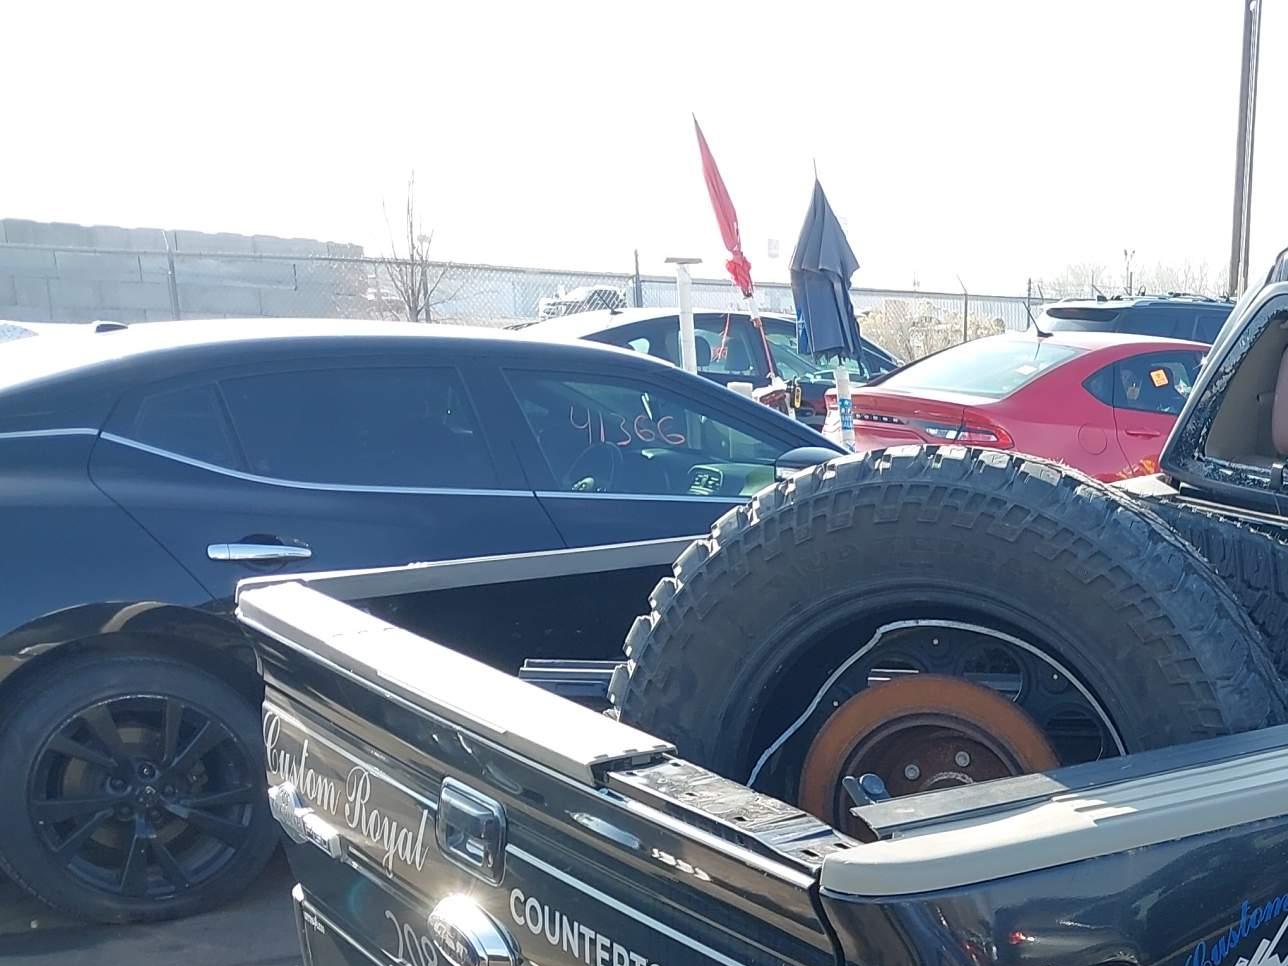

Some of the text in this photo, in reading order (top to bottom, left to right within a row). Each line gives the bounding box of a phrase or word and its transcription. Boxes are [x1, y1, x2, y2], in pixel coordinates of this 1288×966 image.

[569, 405, 686, 446] 41366
[262, 711, 431, 879] Custom Royal
